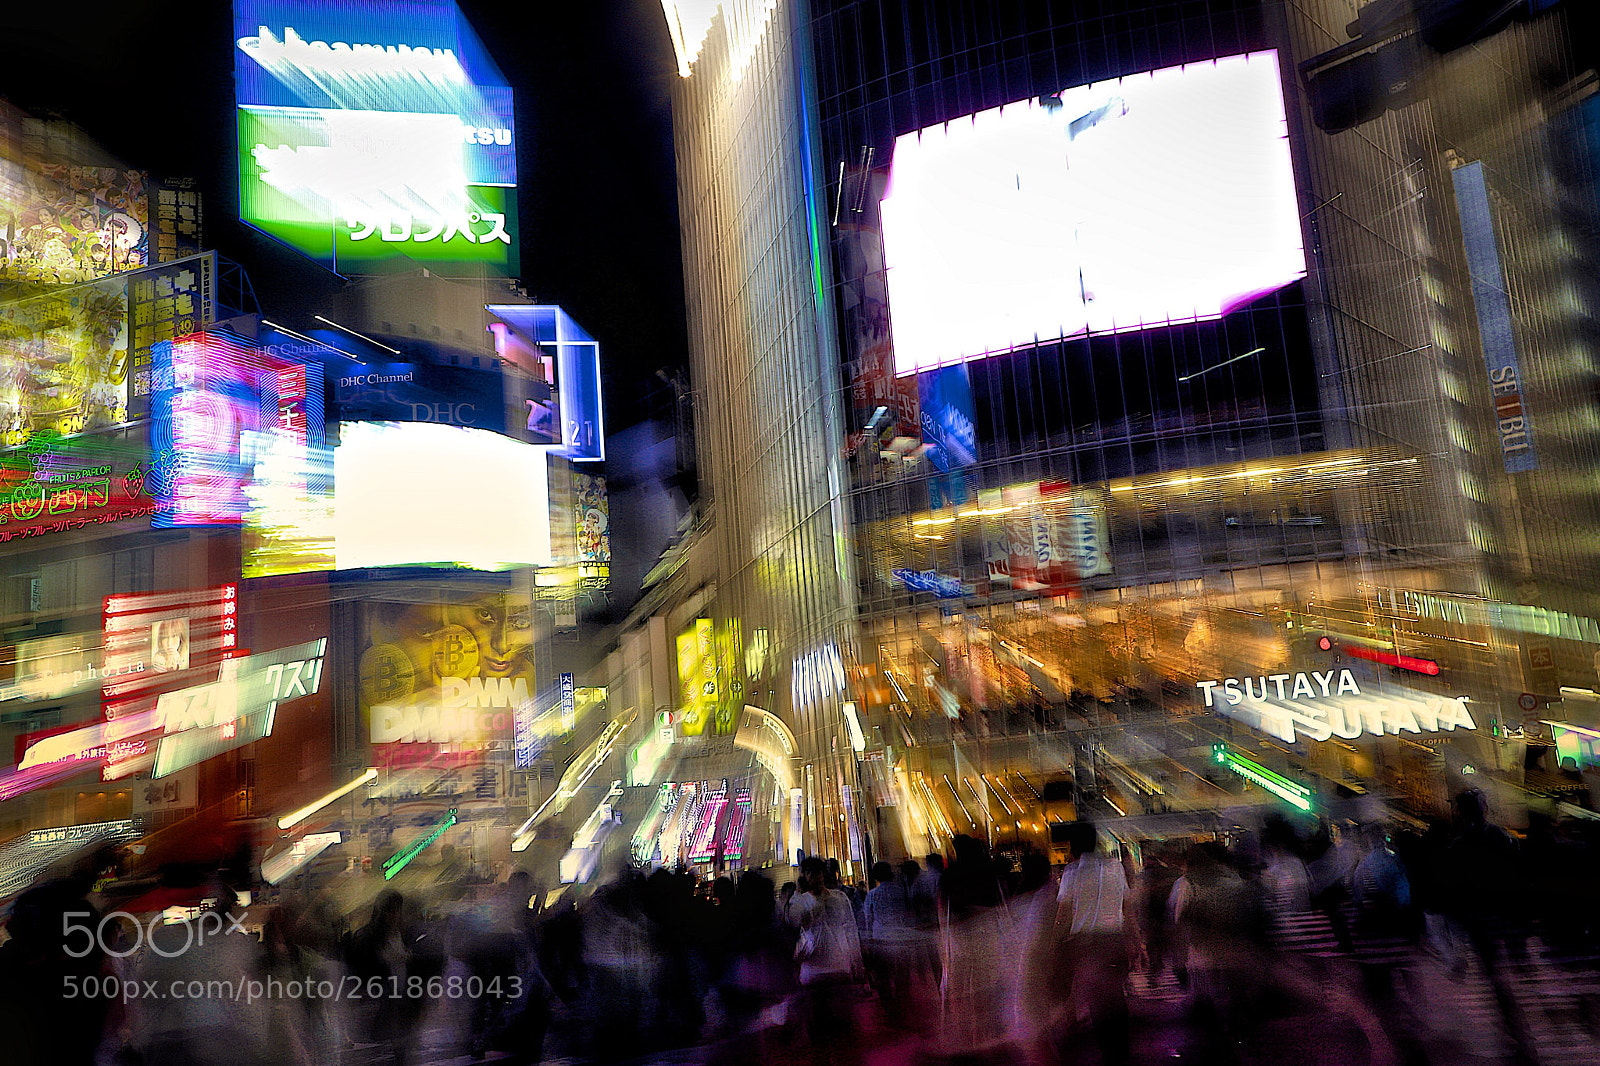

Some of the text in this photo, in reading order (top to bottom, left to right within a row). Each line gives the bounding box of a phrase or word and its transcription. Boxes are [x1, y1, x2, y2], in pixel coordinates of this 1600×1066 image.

[340, 372, 413, 388] DHC Channel
[410, 402, 476, 425] DHC
[1490, 365, 1529, 453] SEIBU
[567, 420, 593, 446] 21
[49, 478, 111, 515] 西村
[265, 659, 324, 699] クスリ
[442, 677, 531, 707] DMM
[1197, 669, 1361, 707] TSUTAYA
[1272, 697, 1476, 744] TSUTAYA
[1554, 783, 1590, 792] COFFEE
